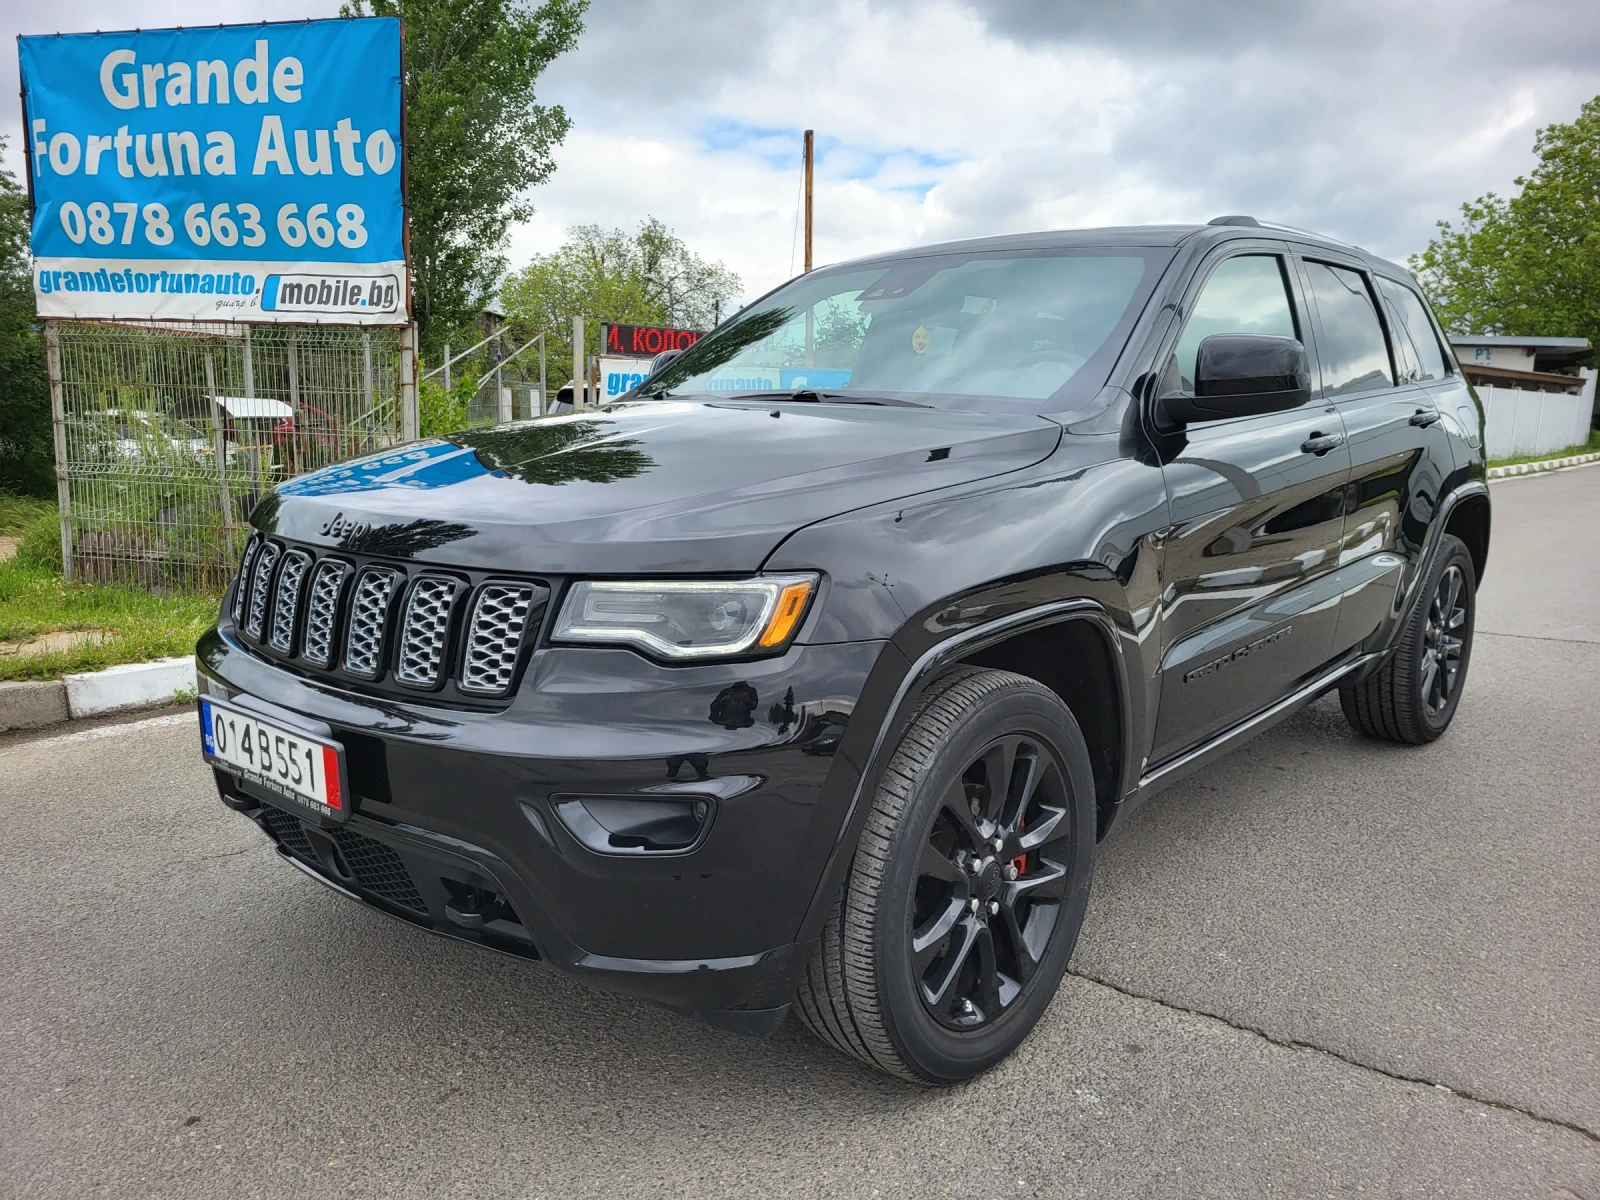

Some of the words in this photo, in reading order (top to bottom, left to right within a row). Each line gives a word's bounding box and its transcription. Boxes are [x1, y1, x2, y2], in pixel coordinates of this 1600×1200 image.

[100, 39, 304, 110] Grande
[32, 117, 237, 178] Fortuna
[252, 115, 396, 176] Auto
[60, 201, 175, 246] 0878
[184, 203, 267, 248] 663
[277, 203, 369, 249] 668
[280, 279, 395, 309] mobile.bg
[319, 512, 372, 544] Jeep
[205, 733, 215, 748] BG
[243, 769, 264, 785] Grande
[263, 777, 283, 794] Fortuna
[283, 785, 296, 801] Auto
